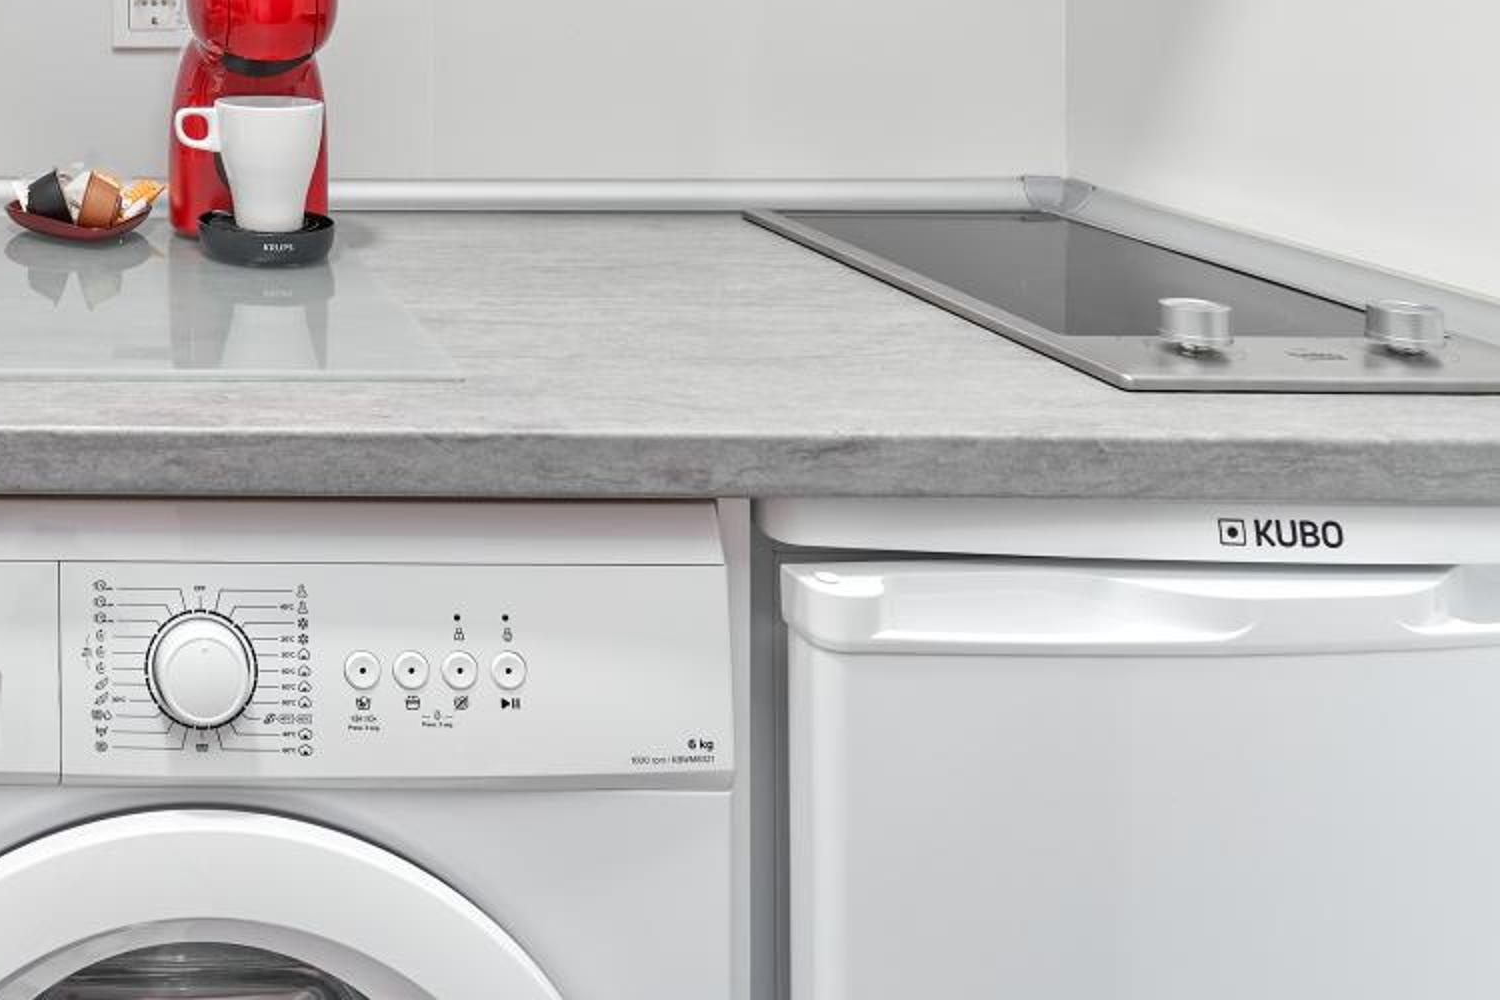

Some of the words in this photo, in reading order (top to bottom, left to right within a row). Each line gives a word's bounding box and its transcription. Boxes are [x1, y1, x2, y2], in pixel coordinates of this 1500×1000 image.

[1253, 518, 1344, 549] KUBO
[687, 738, 697, 750] 6
[699, 737, 714, 753] kg
